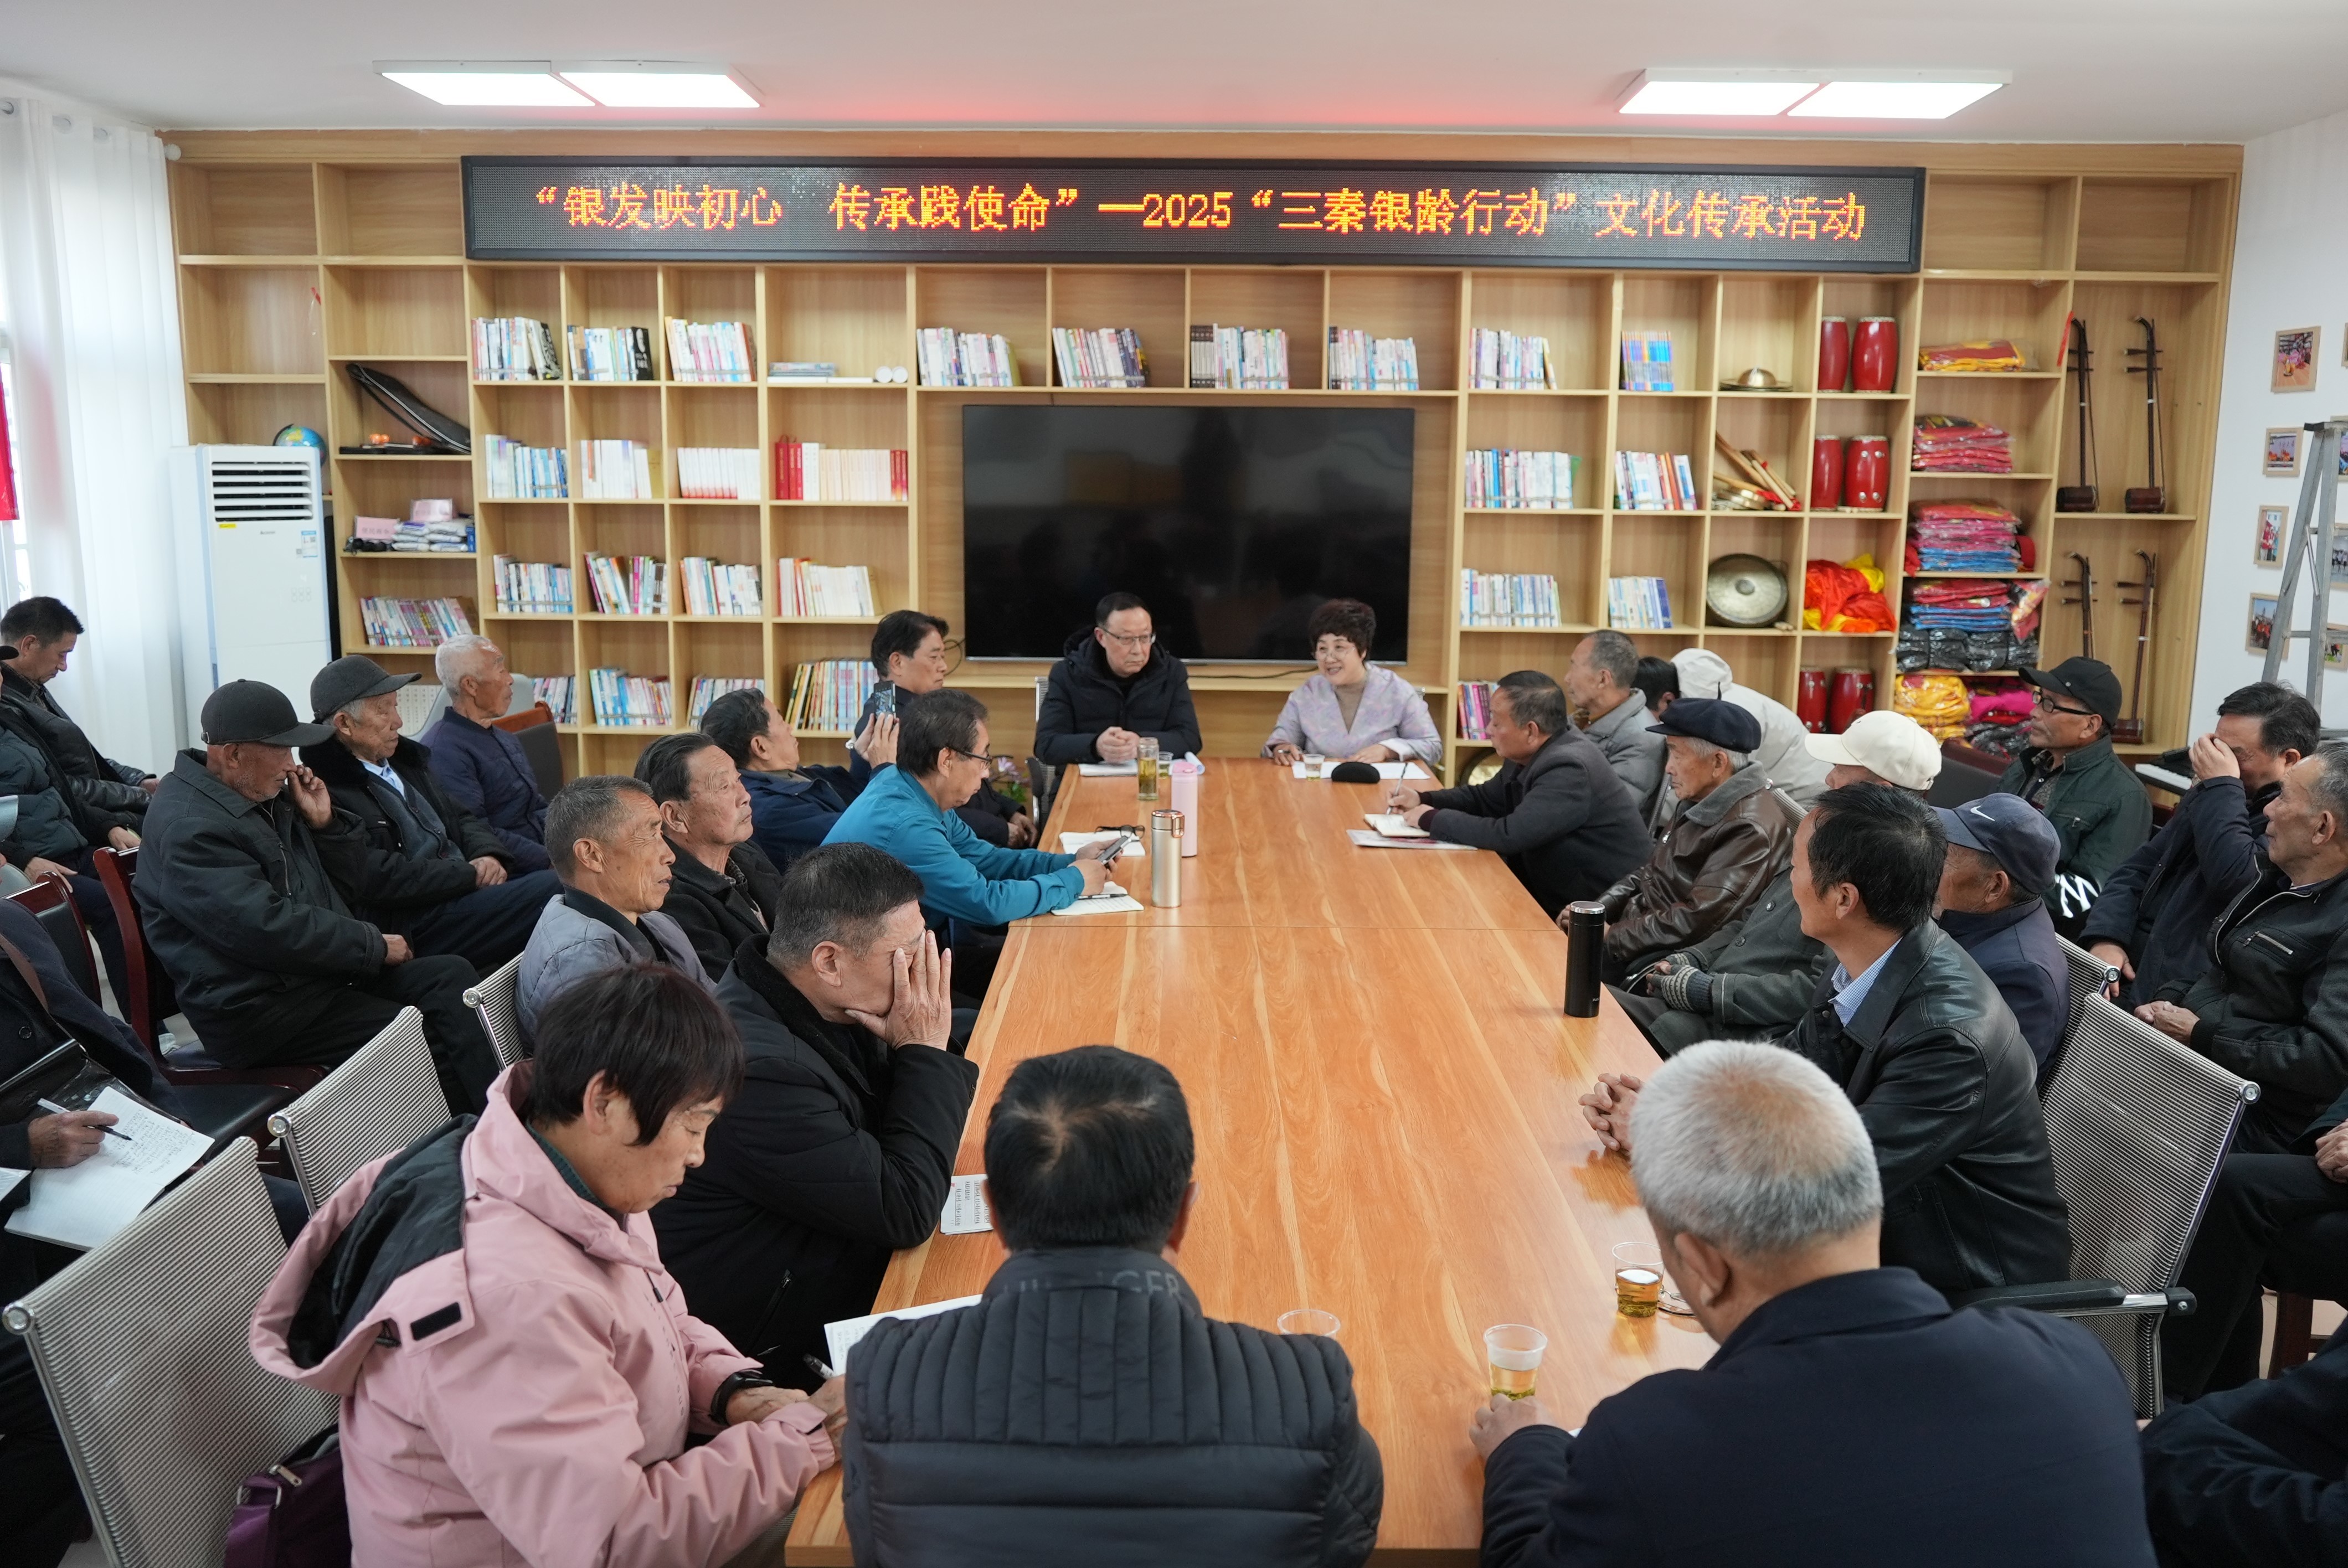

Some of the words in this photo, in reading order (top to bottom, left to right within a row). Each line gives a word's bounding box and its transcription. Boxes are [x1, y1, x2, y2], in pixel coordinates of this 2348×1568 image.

[535, 185, 783, 230] “银发映初心
